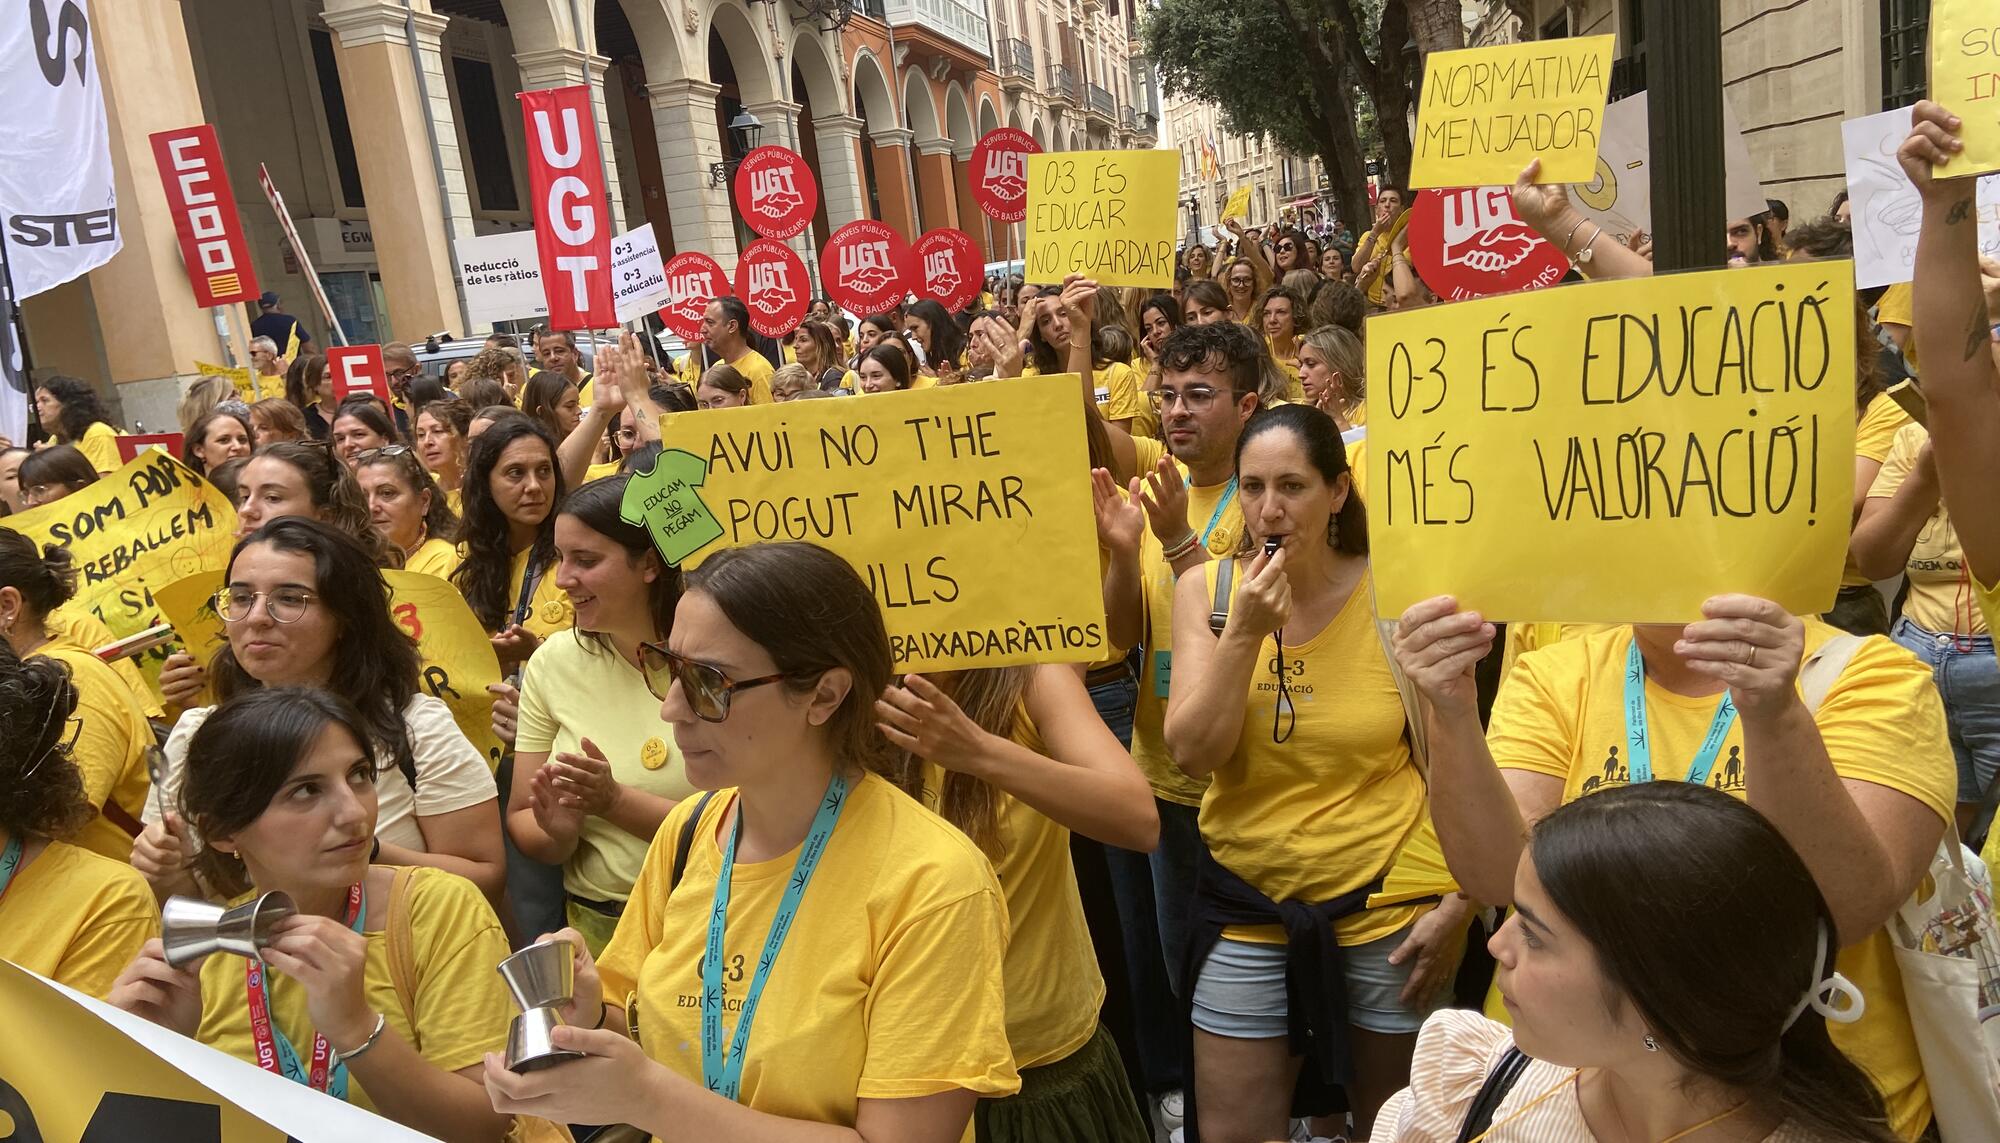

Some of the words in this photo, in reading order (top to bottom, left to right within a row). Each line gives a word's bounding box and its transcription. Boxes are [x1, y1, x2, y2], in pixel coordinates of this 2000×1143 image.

[1428, 53, 1603, 108] NORMATIVA
[1421, 107, 1597, 159] MENJADOR
[750, 166, 796, 200] UGT
[1093, 157, 1127, 194] ÉS
[168, 136, 235, 273] CCOO
[533, 108, 598, 312] UGT
[1035, 199, 1126, 233] EDUCAR
[776, 217, 806, 239] BALEARS
[833, 225, 860, 246] SERVEIS
[464, 258, 519, 274] Reducció
[839, 240, 891, 275] UGT
[923, 248, 956, 281] UGT
[1031, 241, 1060, 276] NO
[1068, 239, 1171, 278] GUARDAR
[467, 274, 482, 285] de
[484, 272, 502, 284] les
[504, 269, 539, 282] ràtios
[621, 274, 664, 297] educatiu
[672, 271, 714, 303] UGT
[748, 261, 789, 294] UGT
[842, 298, 863, 314] ILLES
[865, 292, 900, 314] BALEARS
[768, 315, 798, 336] BALEARS
[1388, 337, 1448, 420] 0-3
[1482, 312, 1540, 413] ÉS
[819, 423, 879, 470] NO
[904, 411, 1000, 461] T'HE
[643, 478, 686, 511] EDUCAM
[1387, 431, 1474, 526] MÉS
[50, 497, 125, 549] SOM
[663, 508, 702, 538] PEGAM
[664, 499, 682, 516] NO
[728, 492, 859, 542] POGUT
[893, 475, 1033, 530] MIRAR
